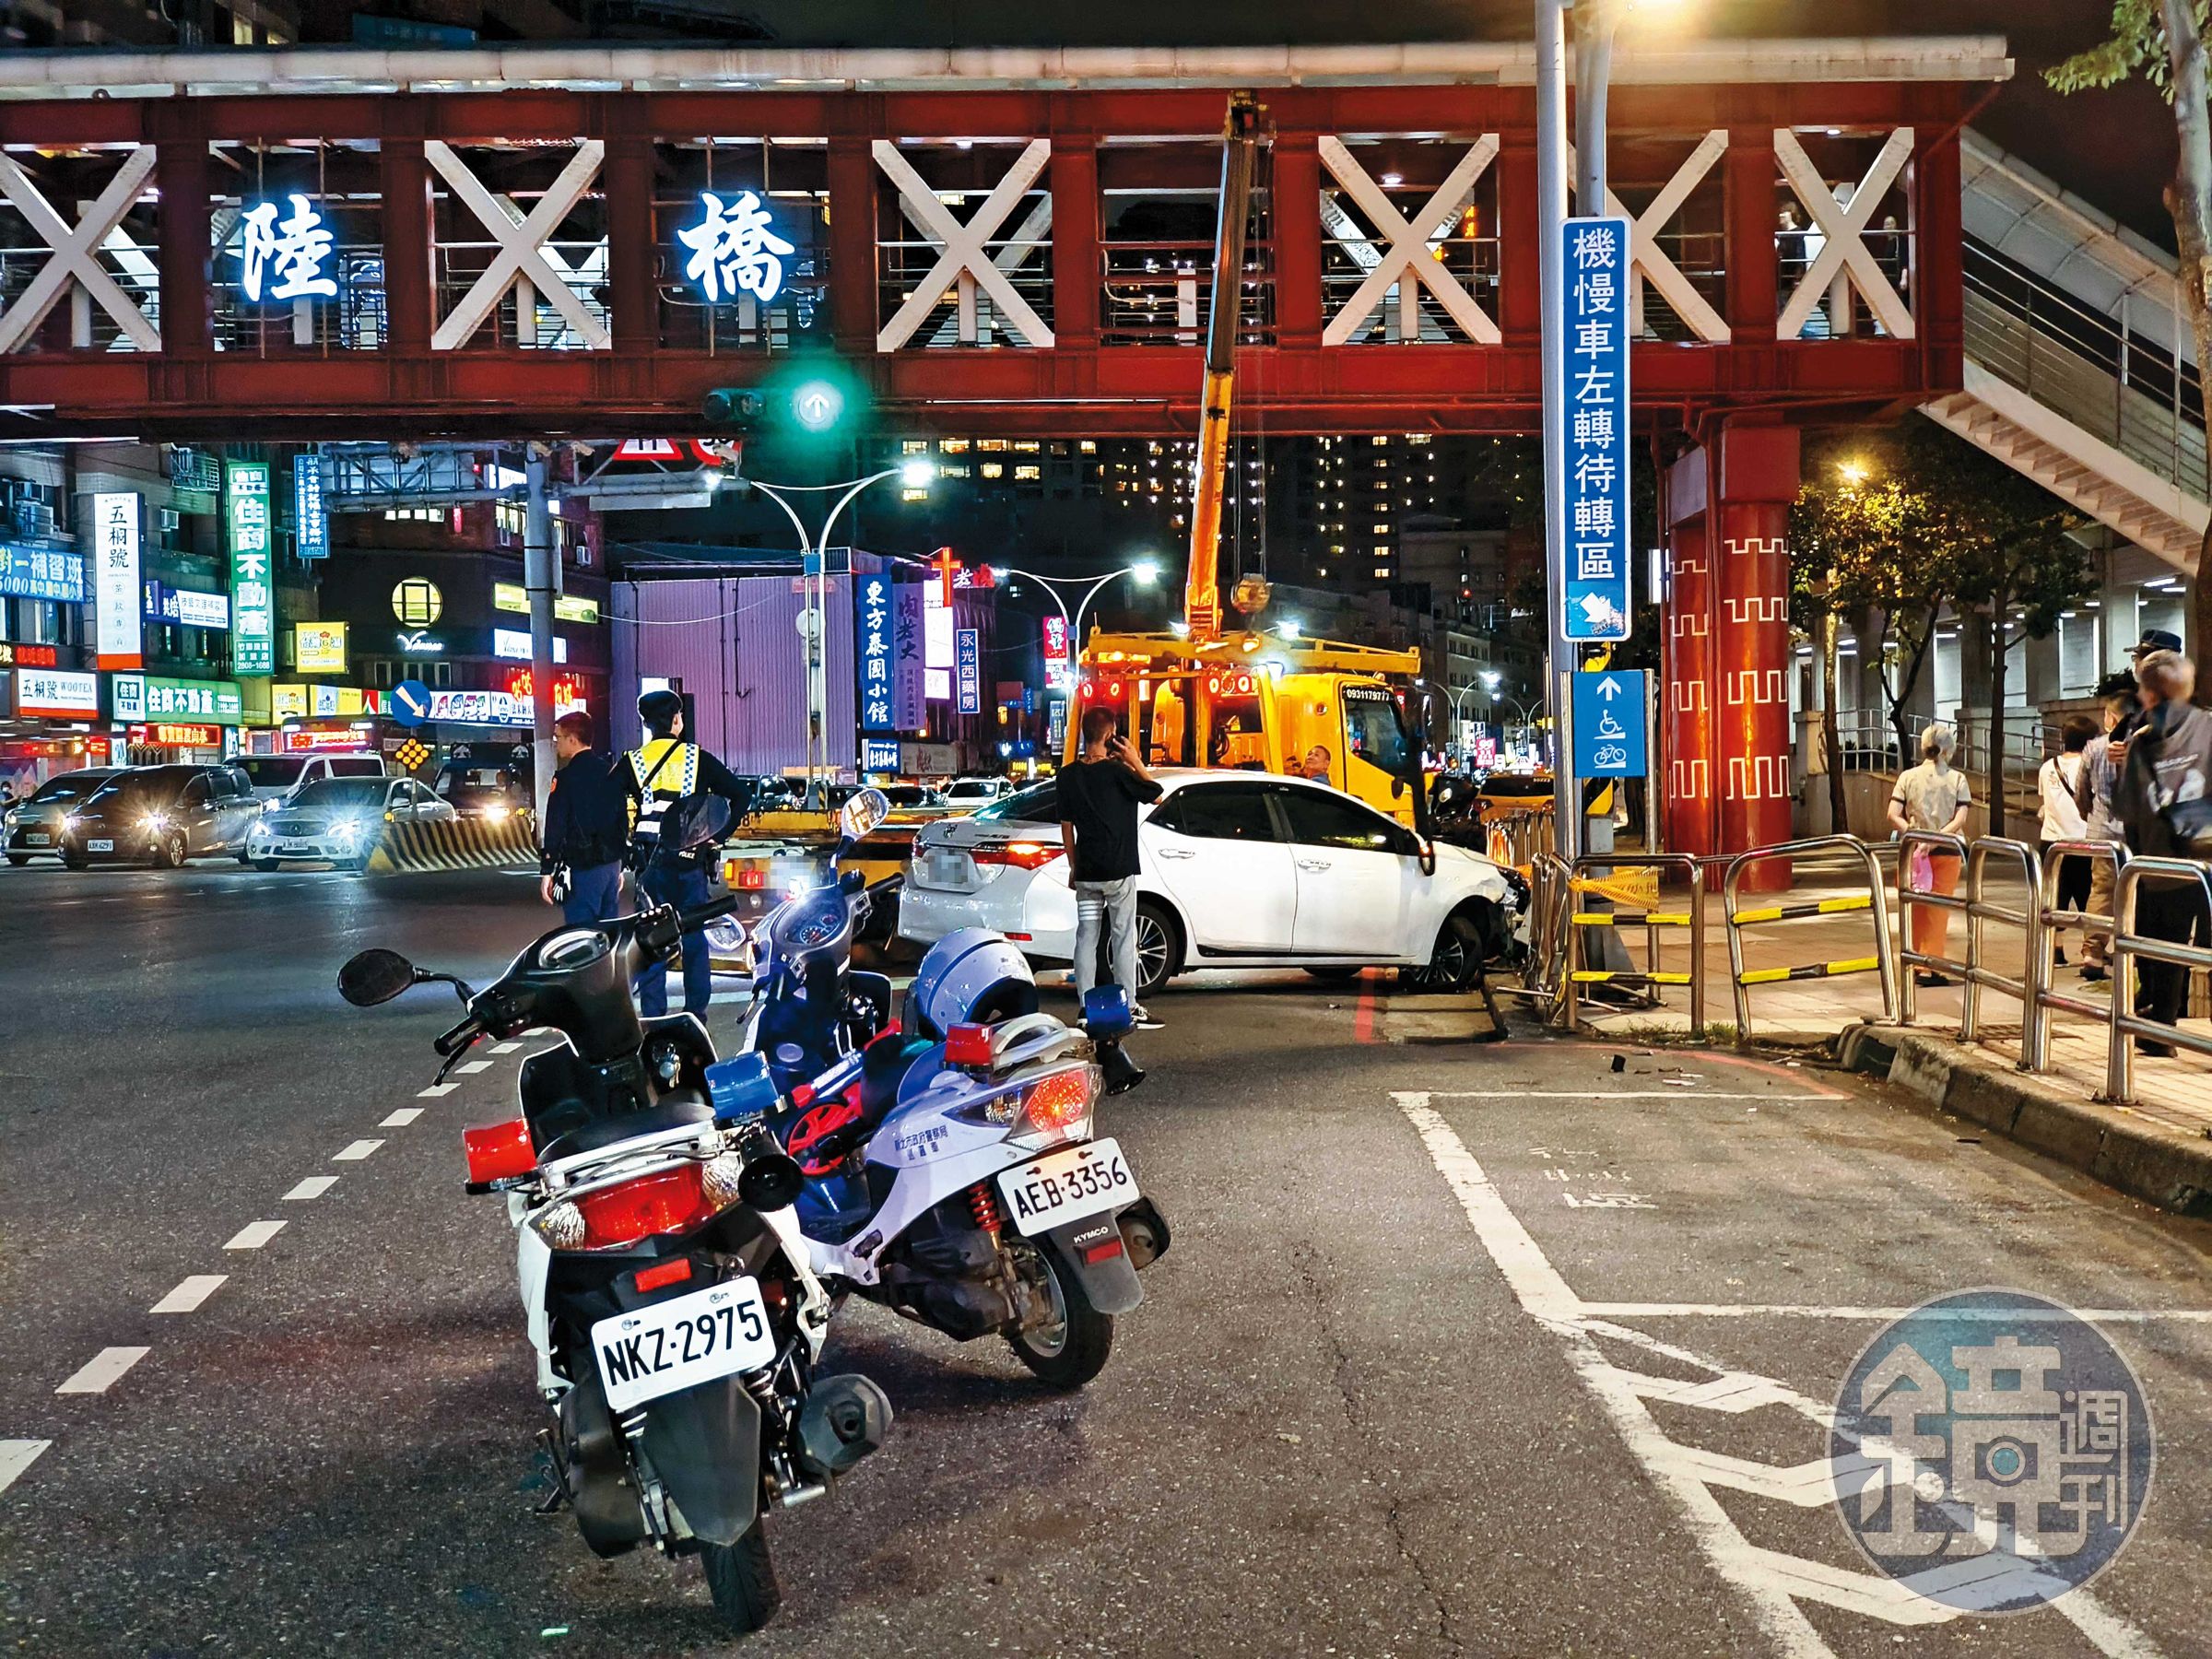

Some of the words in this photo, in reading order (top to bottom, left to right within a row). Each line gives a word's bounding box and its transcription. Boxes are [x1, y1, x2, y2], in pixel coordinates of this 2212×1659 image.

[241, 193, 338, 302] 陸
[677, 190, 795, 303] 橋
[1572, 227, 1617, 580] 機慢車左轉待轉區
[109, 505, 129, 569] 五桐號
[234, 498, 269, 635] 住商不動產
[865, 580, 889, 723] 東方泰國小館
[960, 633, 976, 709] 永光西藥房
[22, 678, 58, 700] 五桐號
[61, 681, 92, 692] WOOTEA
[120, 682, 137, 698] 住商
[147, 686, 214, 714] 住商不動產
[678, 851, 695, 859] POLICE
[1073, 1226, 1109, 1243] KYMCO
